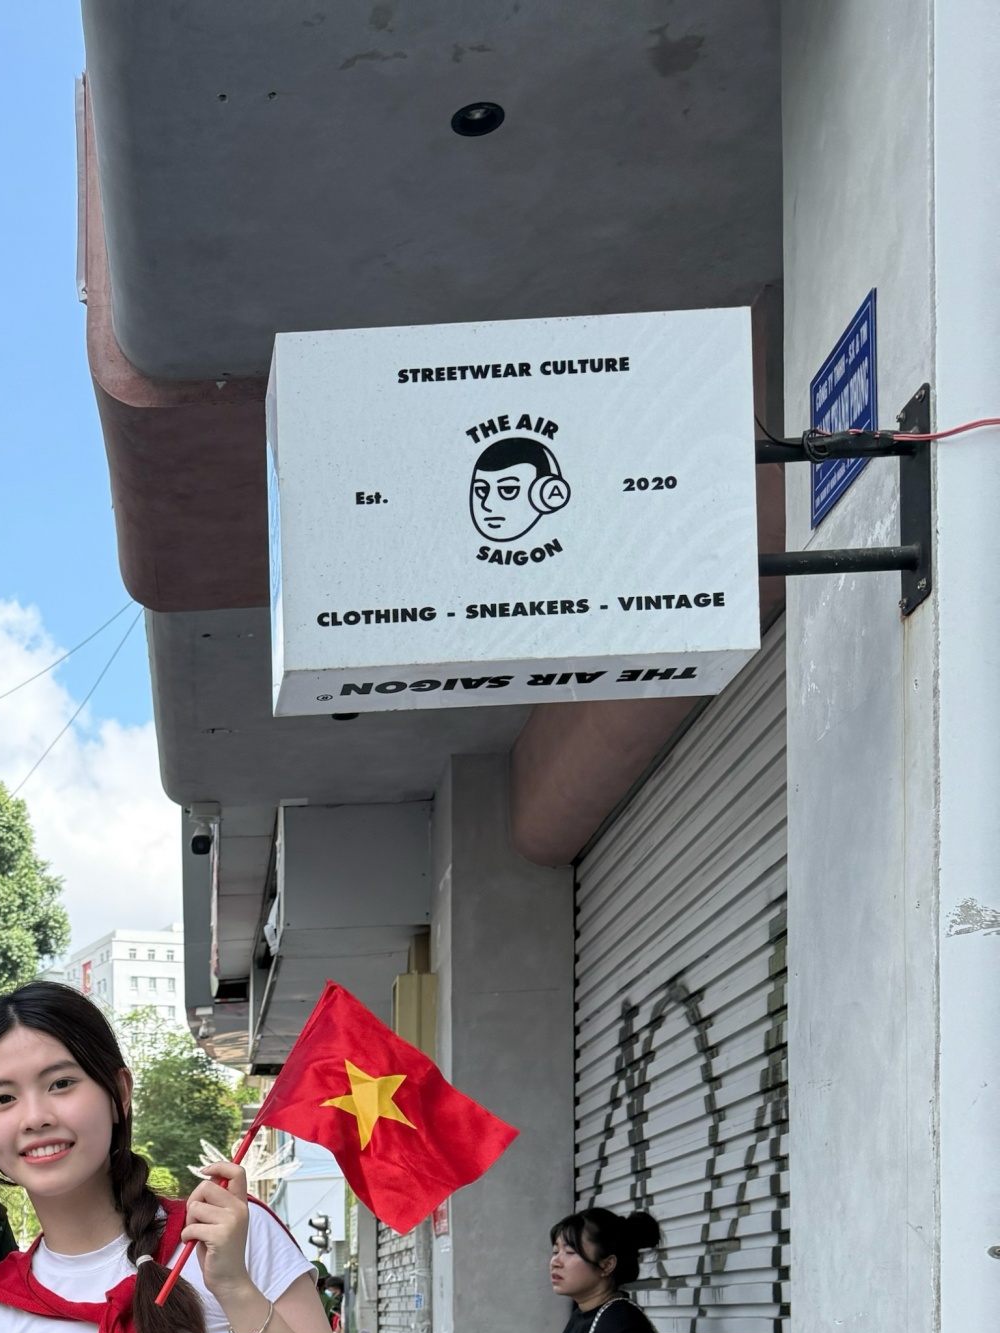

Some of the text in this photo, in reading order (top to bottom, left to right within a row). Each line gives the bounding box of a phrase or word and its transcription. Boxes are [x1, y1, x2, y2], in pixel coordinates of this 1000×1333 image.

[397, 356, 630, 384] STREETWEAR CULTURE
[465, 413, 559, 444] THE AIR
[622, 475, 678, 492] 2020
[355, 491, 389, 505] Est.
[475, 538, 564, 566] SAIGON
[316, 606, 437, 627] CLOTHING
[465, 598, 590, 620] SNEAKERS
[617, 591, 725, 612] VINTAGE
[339, 666, 698, 696] THE AIR SAIGON
